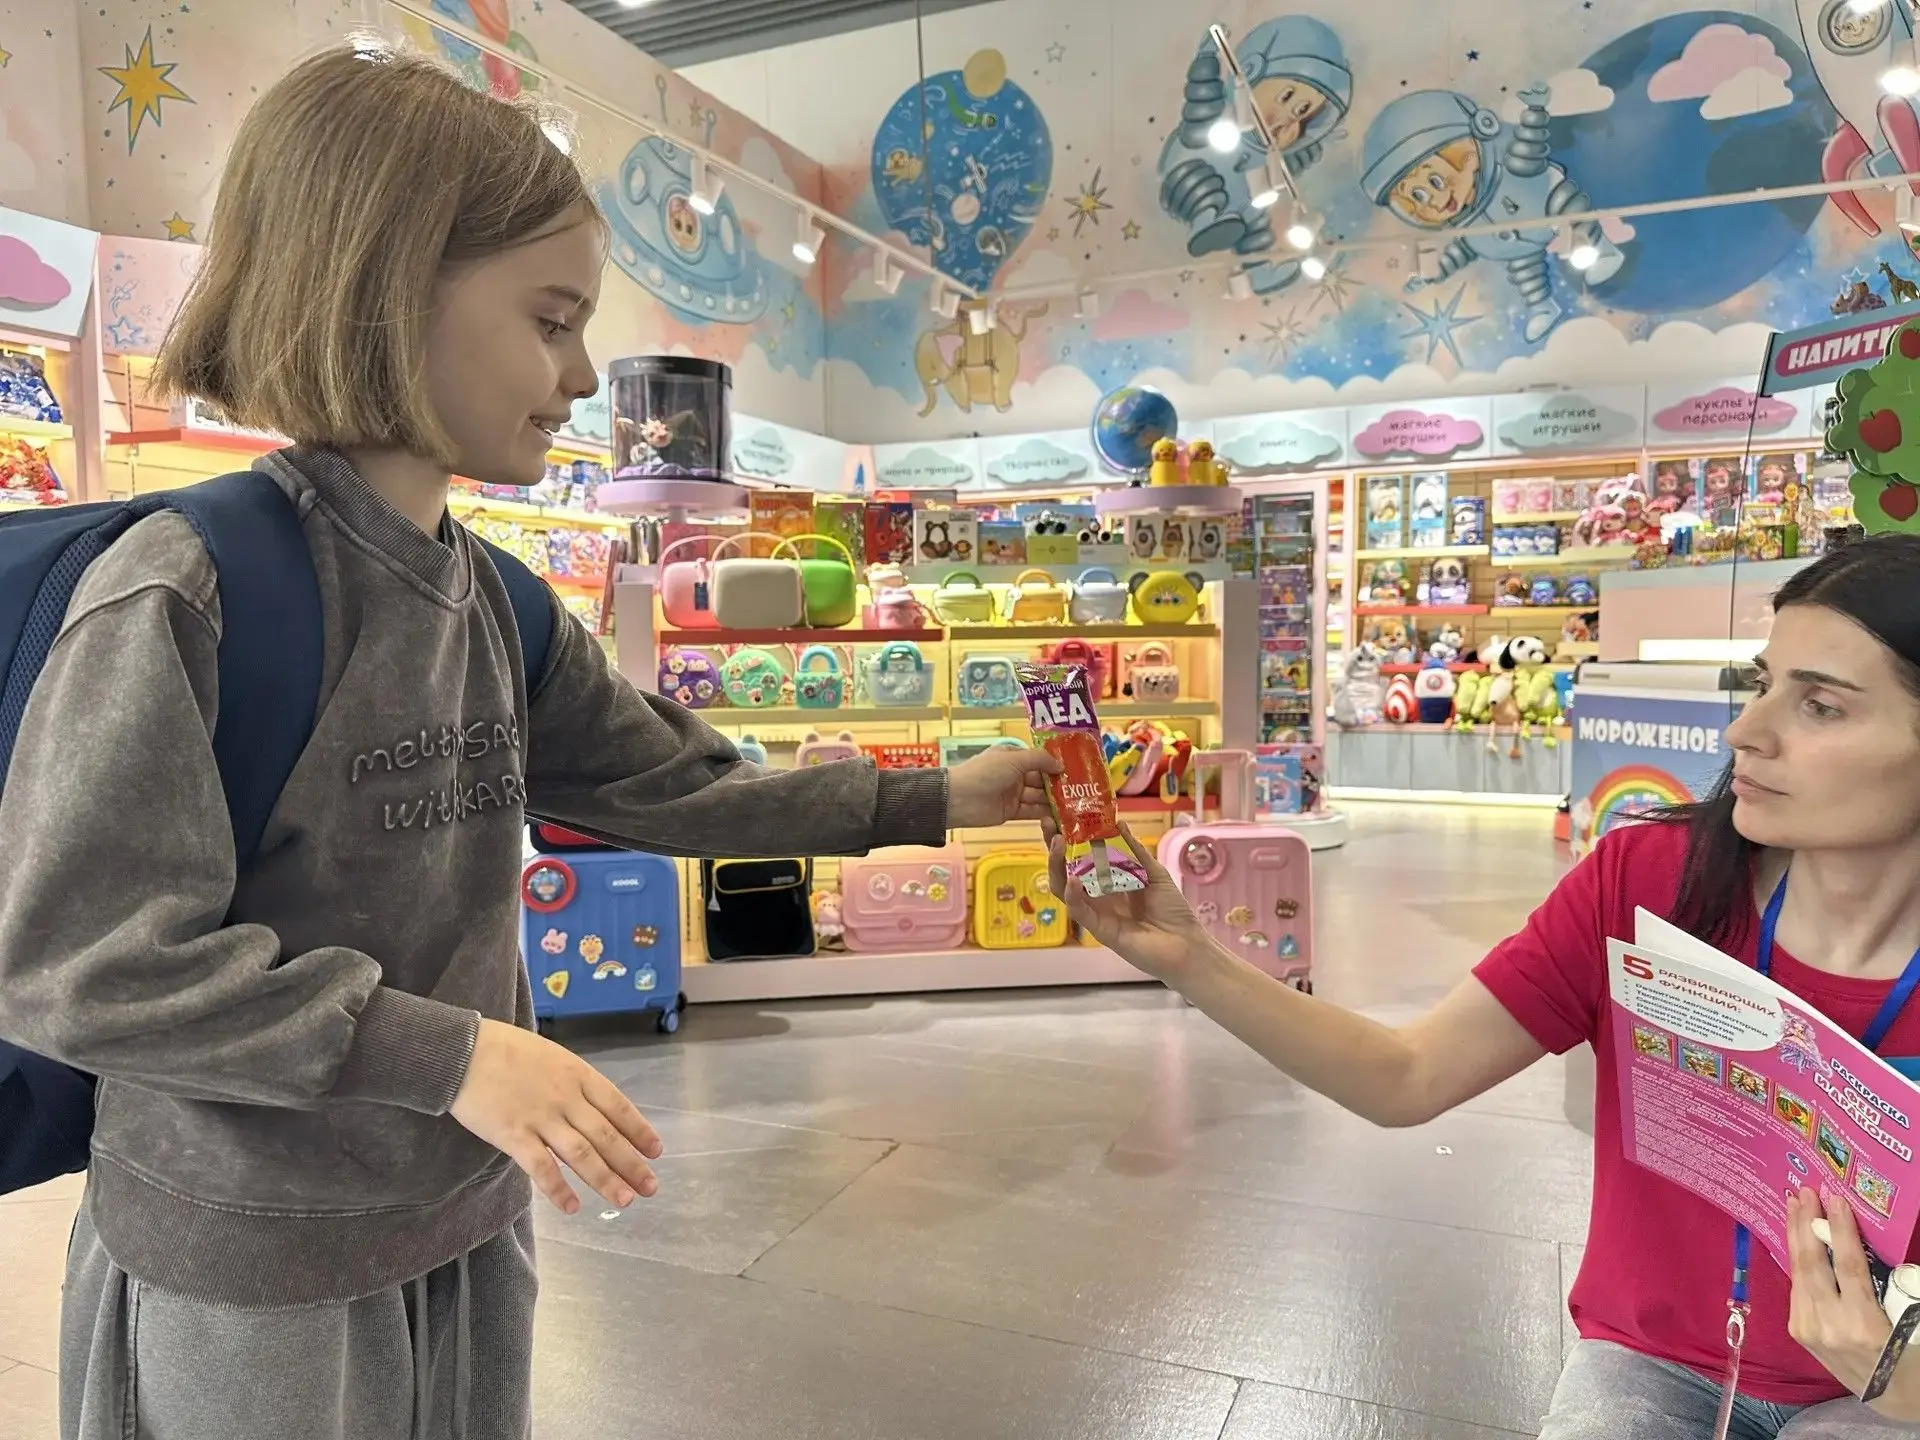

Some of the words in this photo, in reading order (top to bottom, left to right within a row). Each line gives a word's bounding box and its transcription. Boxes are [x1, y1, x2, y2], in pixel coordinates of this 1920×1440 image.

[1025, 680, 1085, 697] ФРУКТОЫЙ
[1033, 691, 1093, 729] ЛЁД
[1578, 717, 1720, 755] МОРОЖЕНОЕ
[1062, 782, 1102, 799] EXOTIC
[1623, 953, 1655, 981] 5
[1658, 968, 1776, 1019] РАЗВИВАЮЩИХ
[1832, 1060, 1909, 1127] РАСКРАСКА
[1846, 1089, 1878, 1122] ФЕИ
[1816, 1074, 1829, 1089] И
[1829, 1089, 1910, 1159] ДРАКОНЫ
